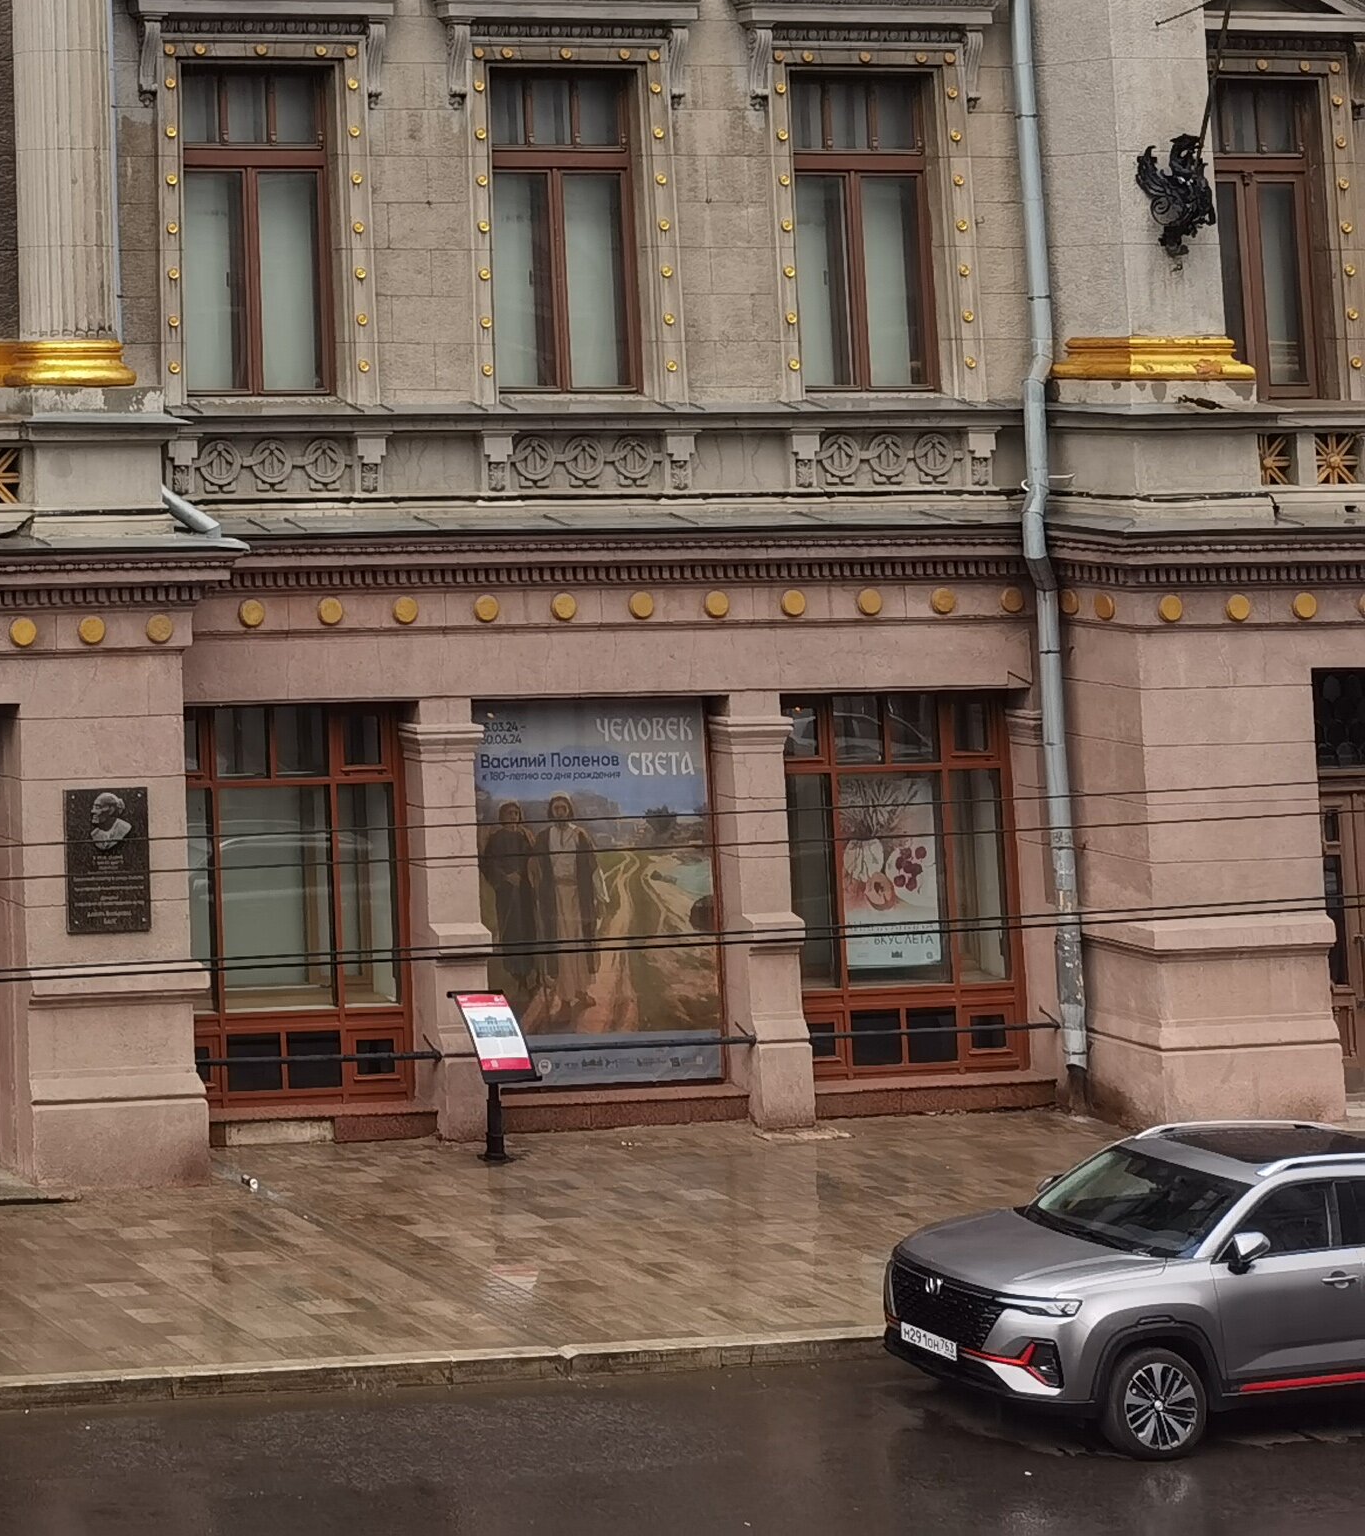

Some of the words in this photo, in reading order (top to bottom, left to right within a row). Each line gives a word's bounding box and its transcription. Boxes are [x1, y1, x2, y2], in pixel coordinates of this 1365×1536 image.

[596, 717, 693, 742] ЧЕЛОВЕК
[480, 753, 546, 768] Василий
[550, 752, 620, 768] Поленов
[627, 751, 695, 776] СВЕТА
